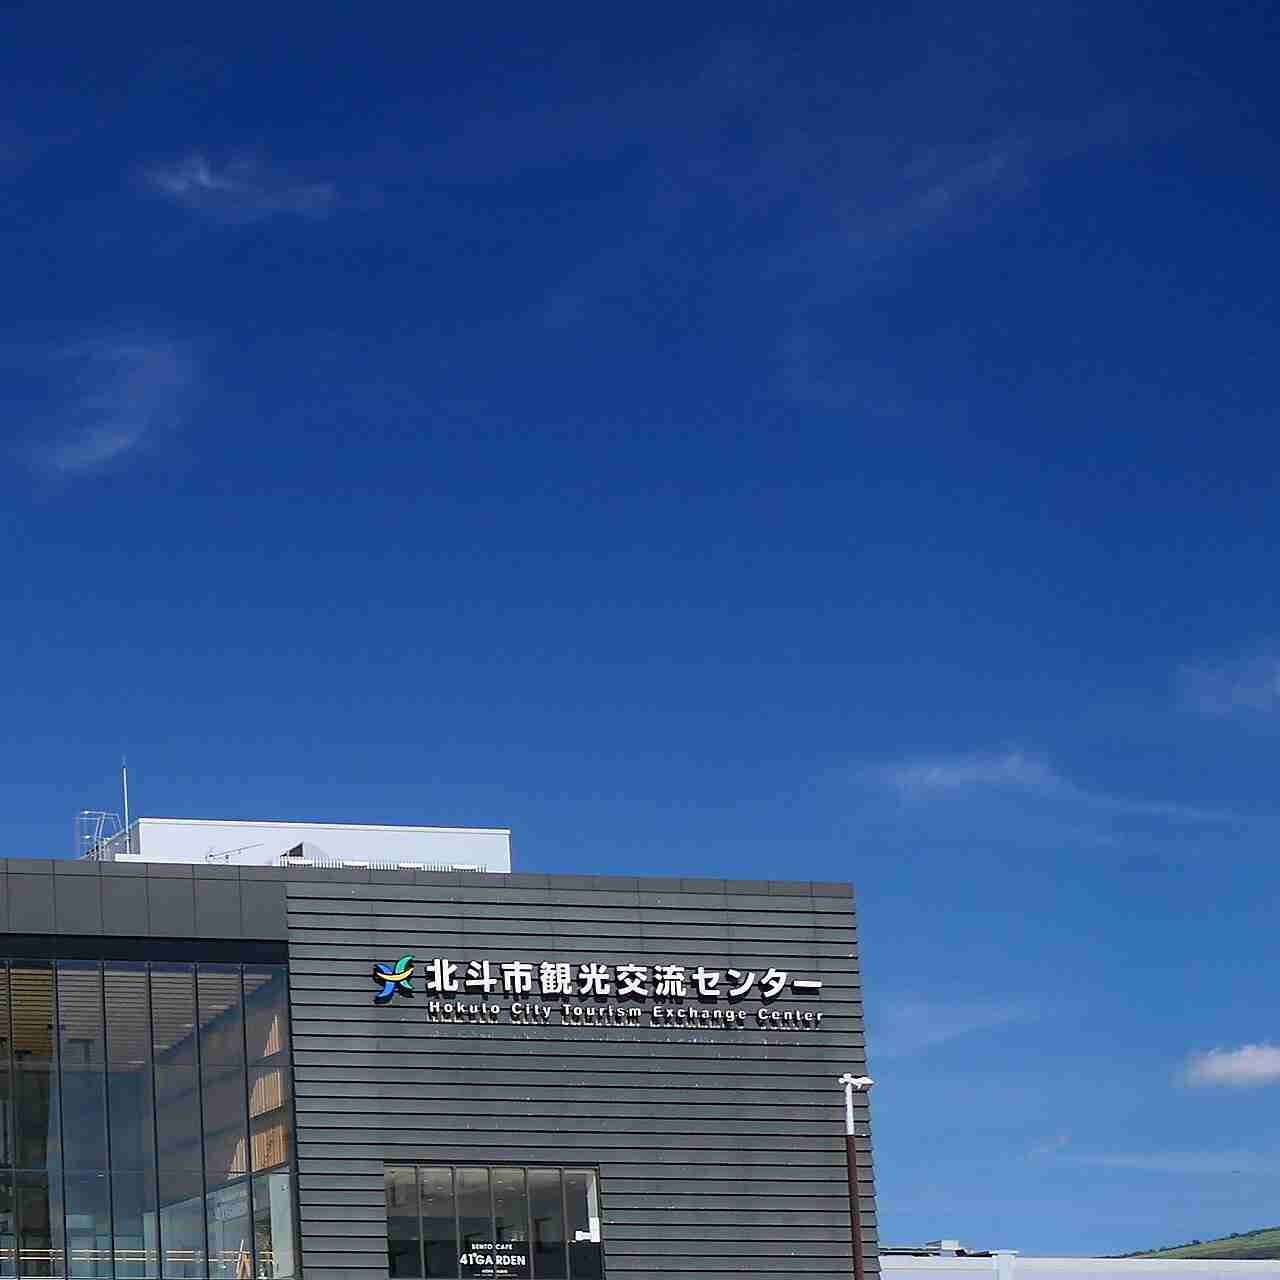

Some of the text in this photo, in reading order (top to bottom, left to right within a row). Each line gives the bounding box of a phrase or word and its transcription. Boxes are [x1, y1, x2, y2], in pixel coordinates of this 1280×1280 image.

[426, 958, 823, 998] 北斗市観光交流センター
[429, 1001, 823, 1022] Hokuto City Tourism Exchange Center
